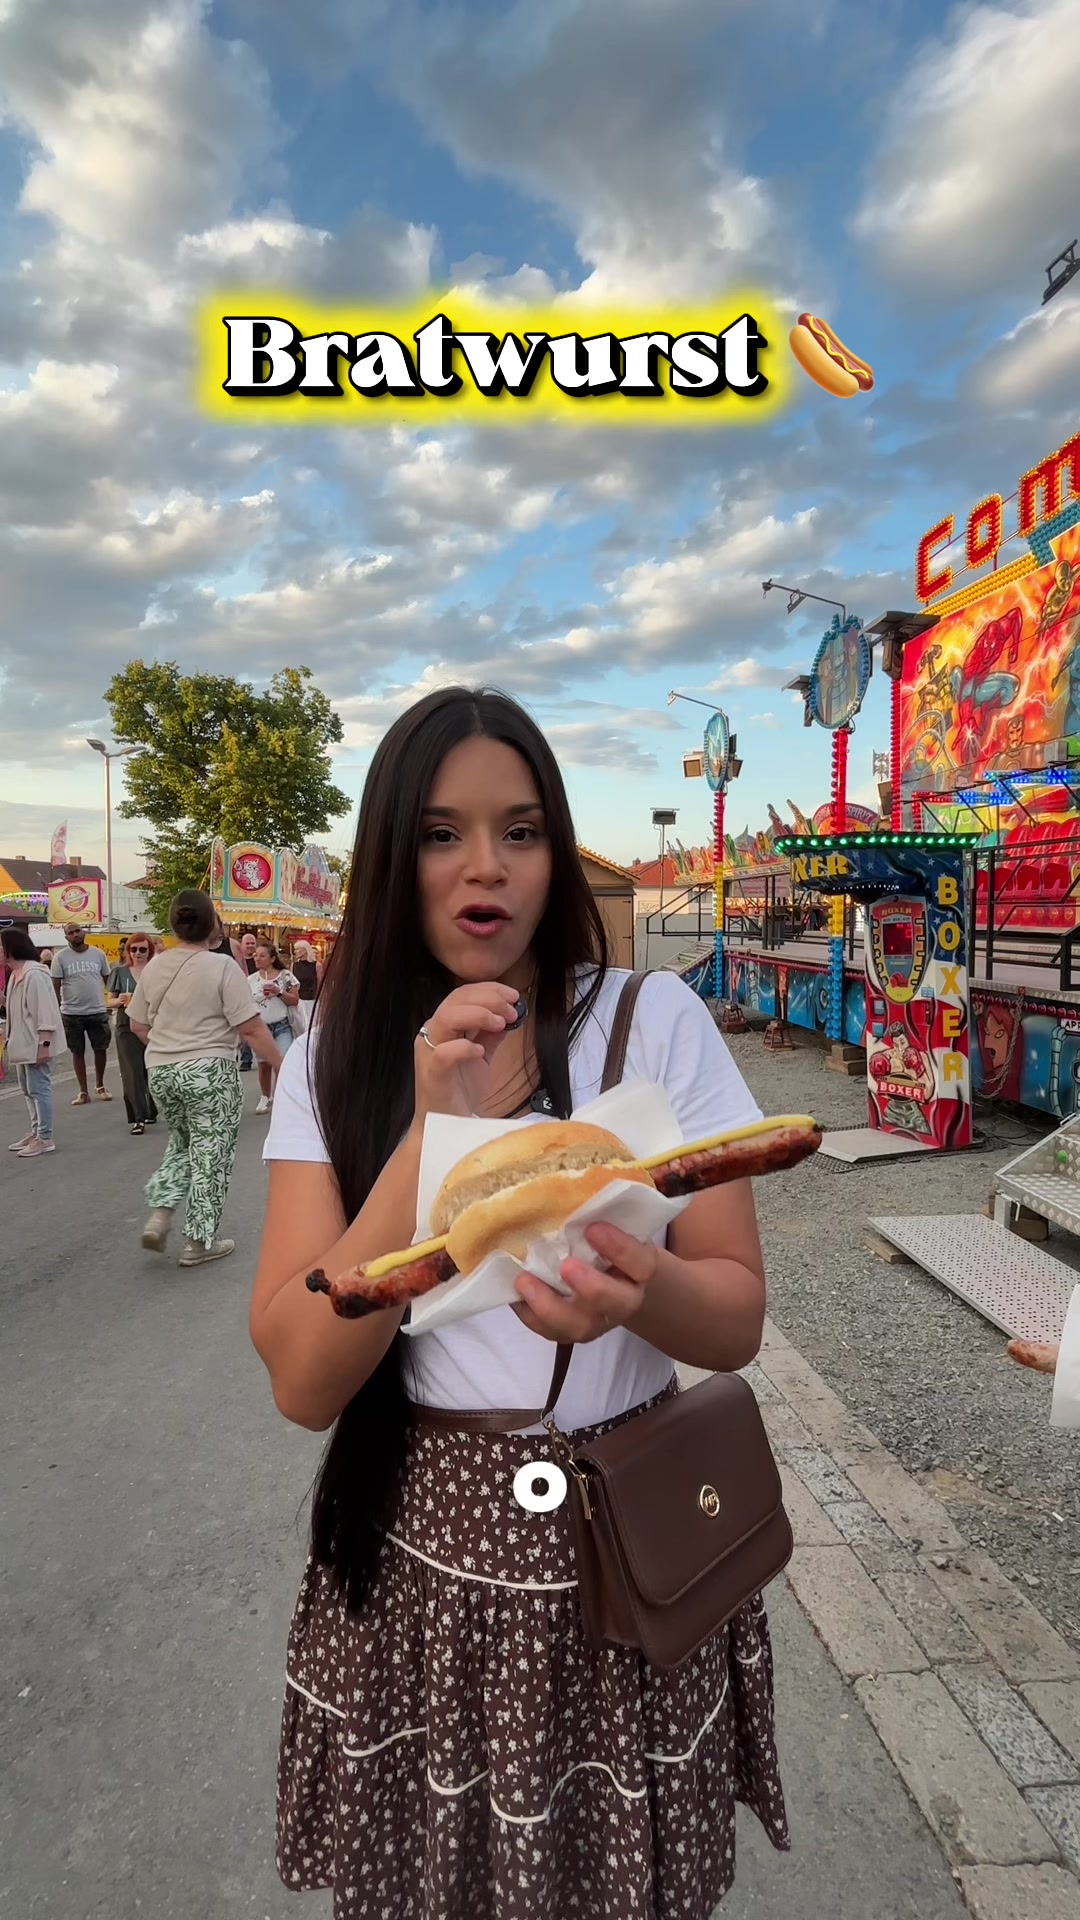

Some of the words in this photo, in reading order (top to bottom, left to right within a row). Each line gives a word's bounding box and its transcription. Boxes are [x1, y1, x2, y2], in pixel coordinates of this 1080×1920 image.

[791, 853, 848, 882] XER
[938, 876, 964, 1082] BOXER
[880, 1081, 921, 1099] BOXER
